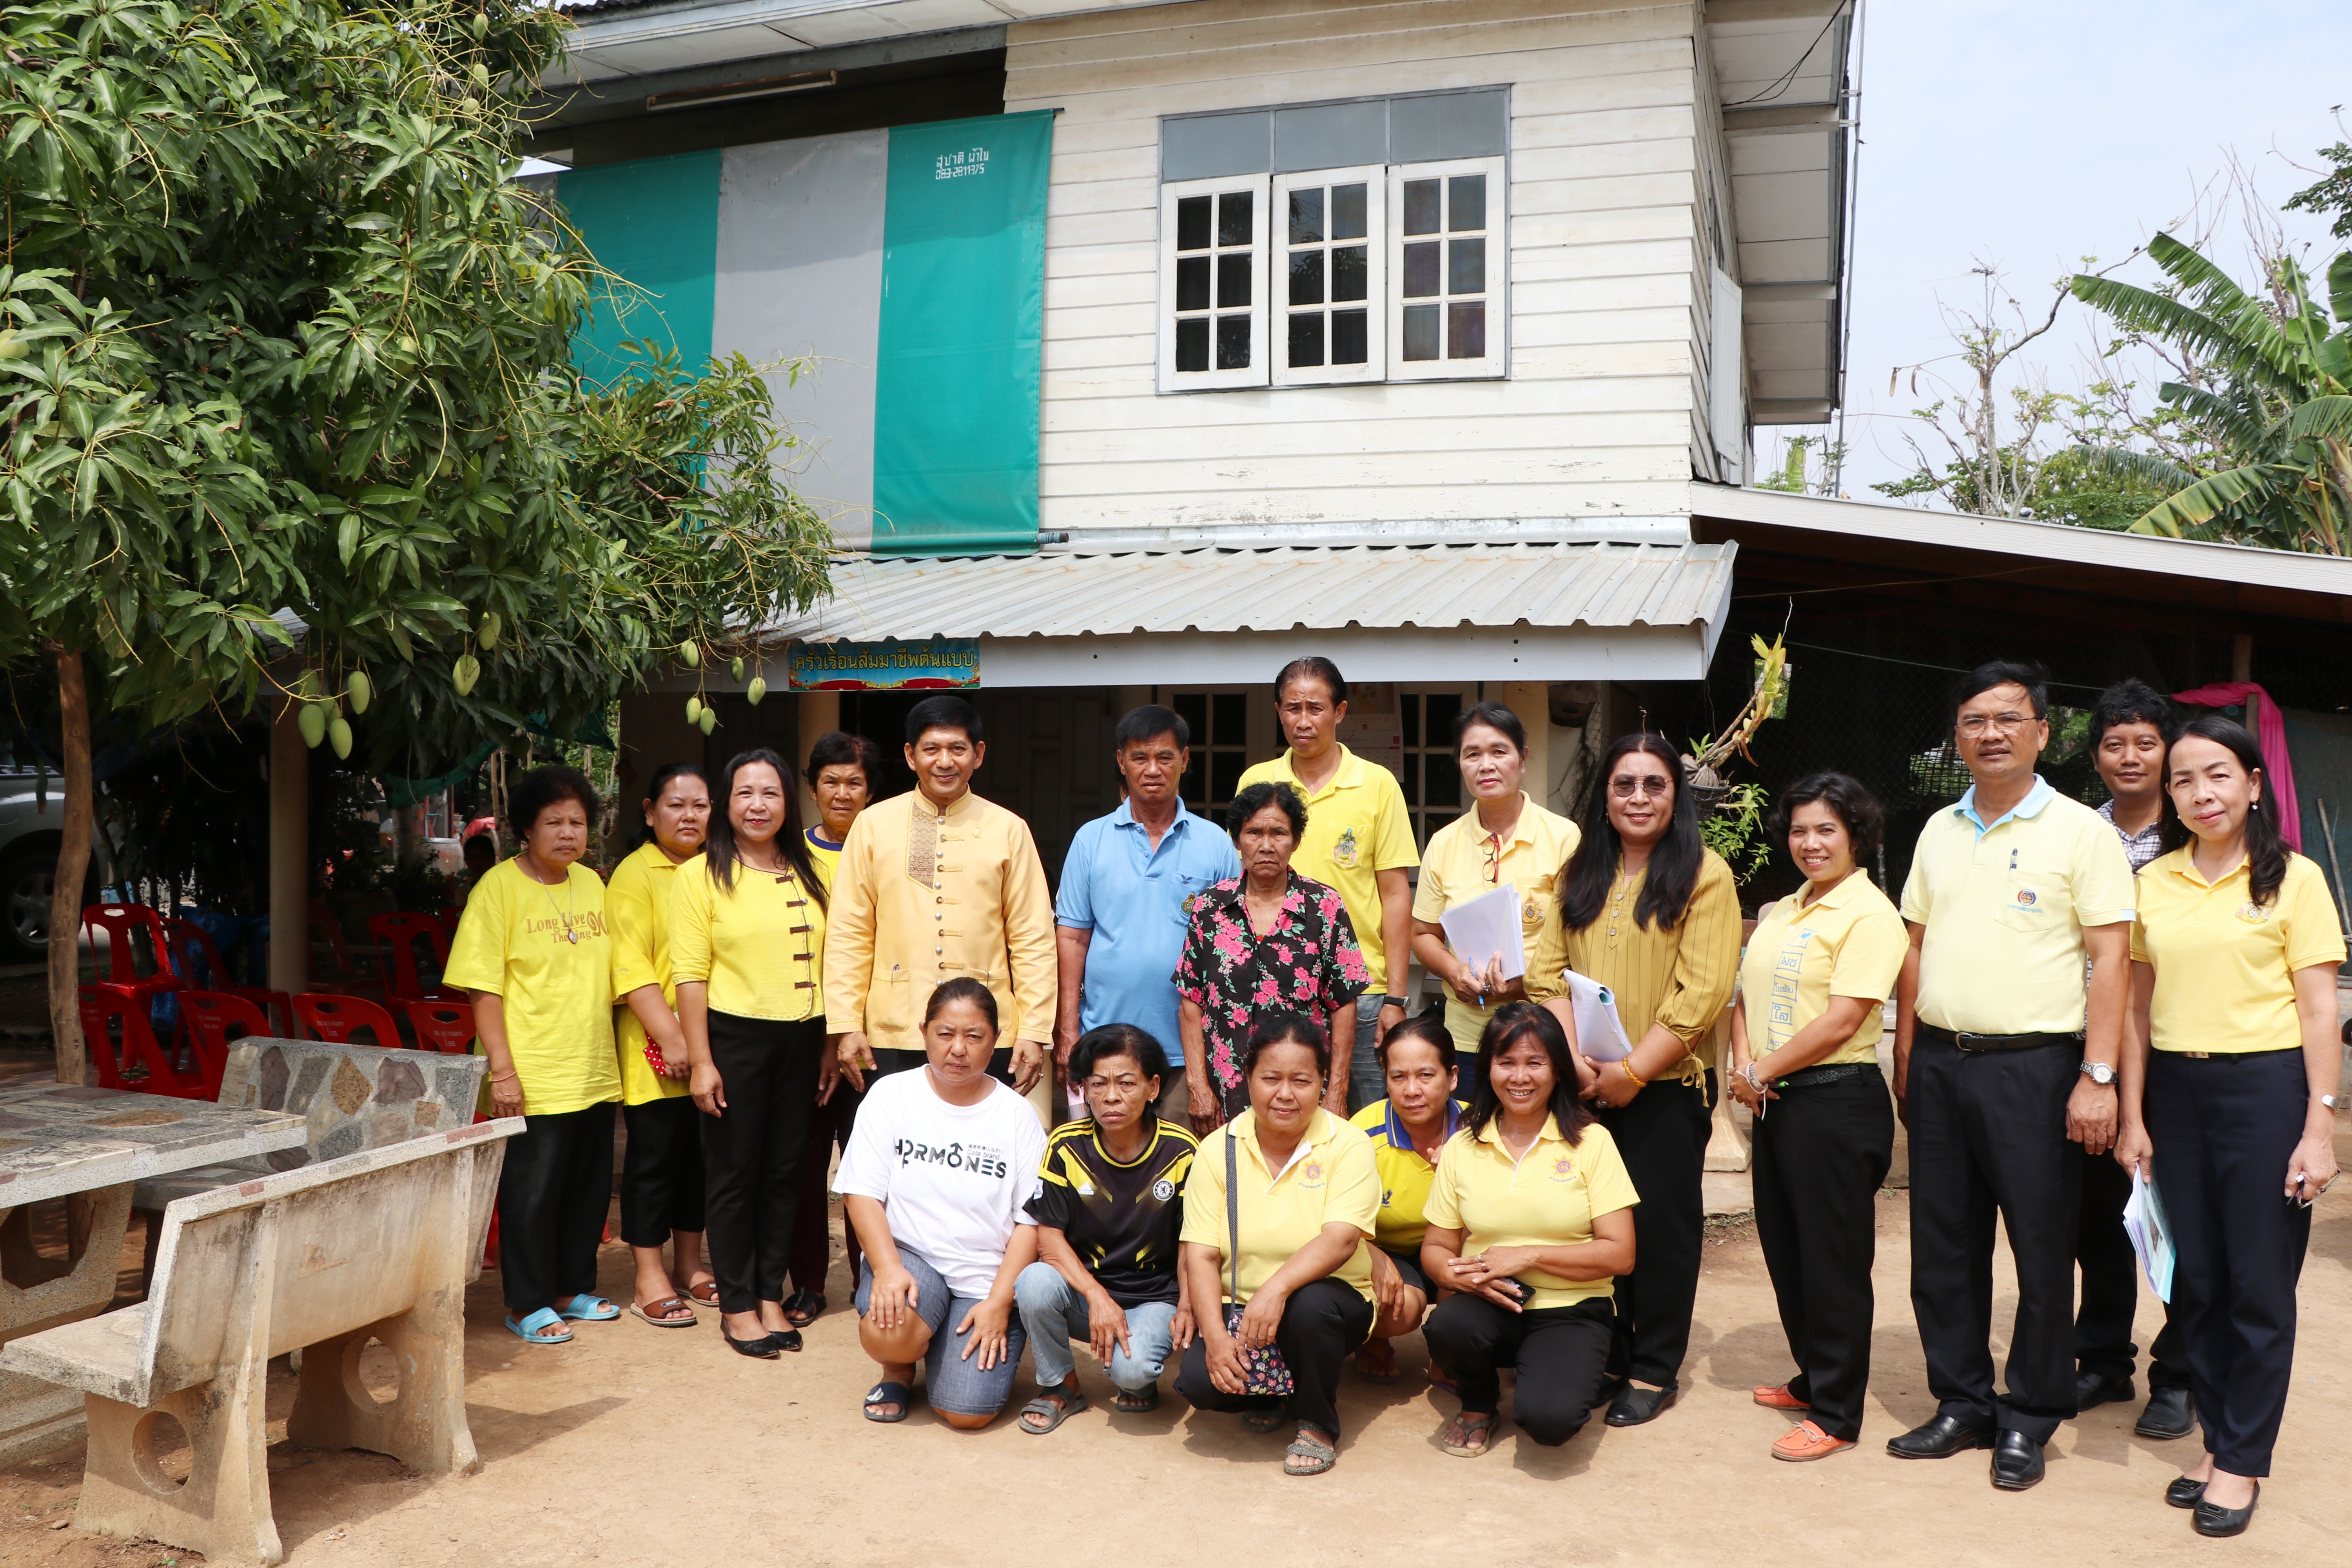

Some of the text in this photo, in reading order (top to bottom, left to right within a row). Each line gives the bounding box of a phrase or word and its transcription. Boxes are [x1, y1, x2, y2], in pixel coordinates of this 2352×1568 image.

[794, 645, 974, 671] ครัวเรือนสัมมาชีพต้นแบบ
[526, 918, 560, 934] Long
[550, 929, 592, 943] The ing
